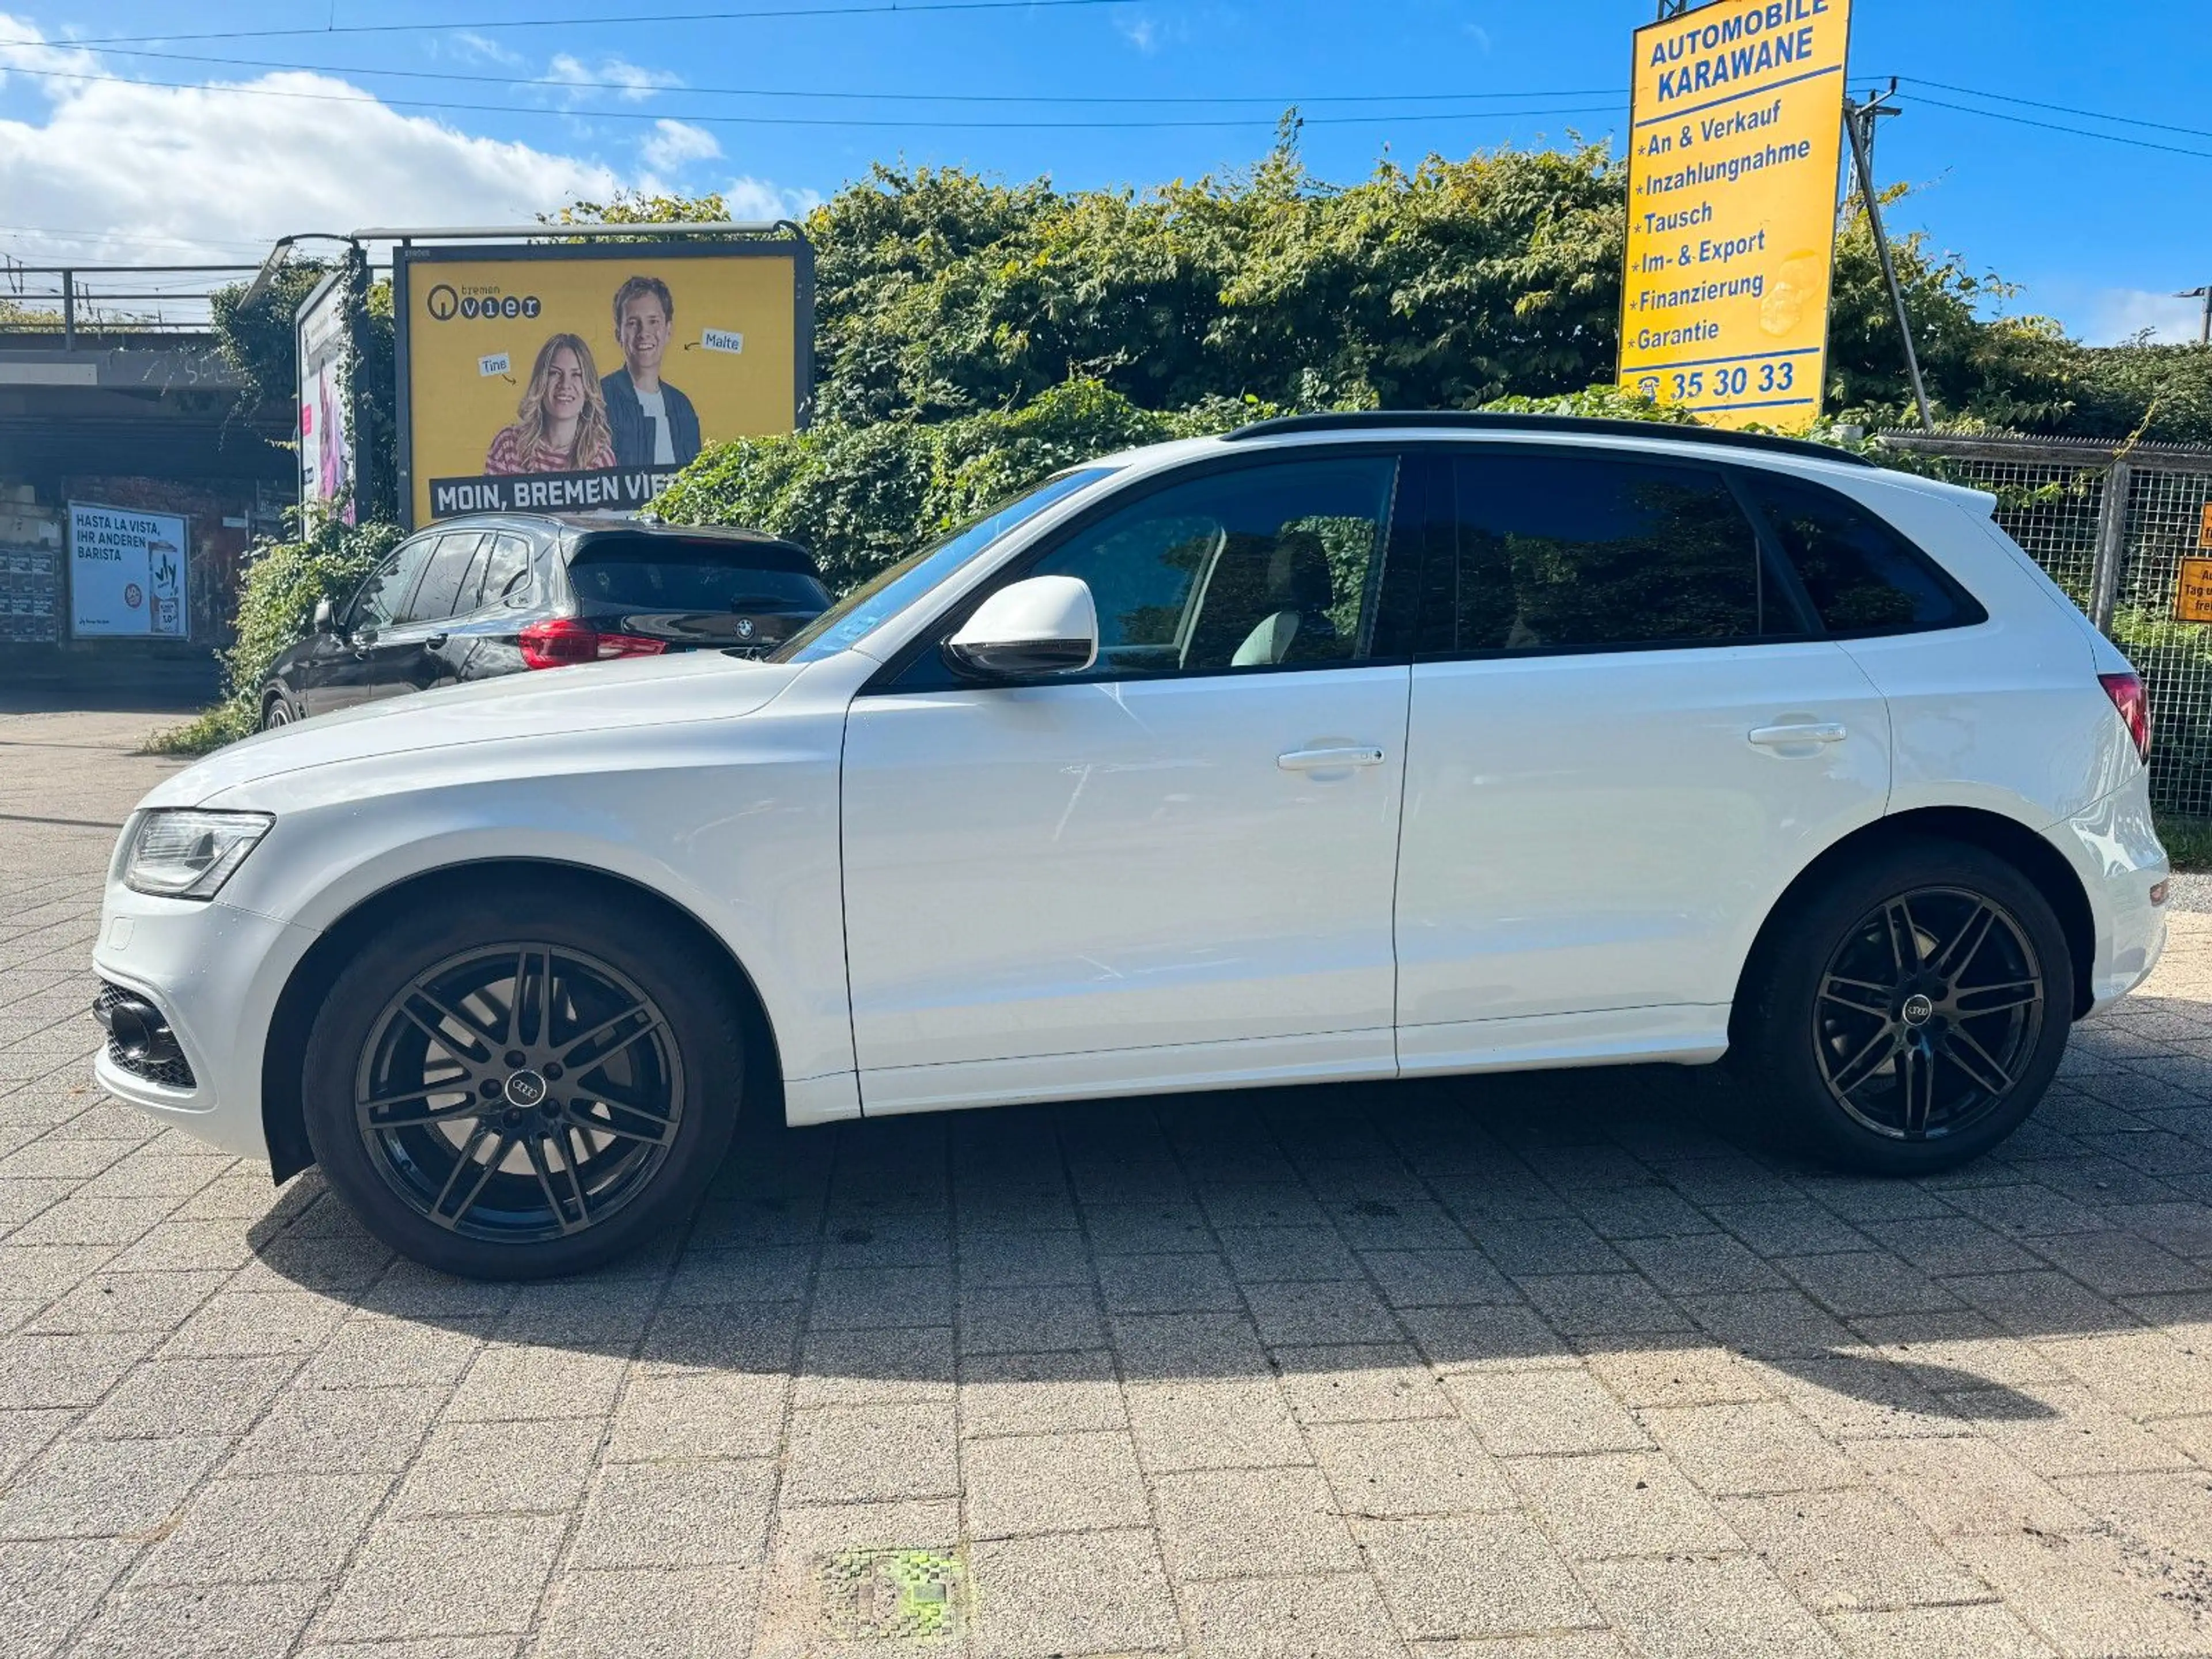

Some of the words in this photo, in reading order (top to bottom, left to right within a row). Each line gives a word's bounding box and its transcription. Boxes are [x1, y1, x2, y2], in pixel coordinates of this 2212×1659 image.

[1650, 0, 1828, 67] AUTOMOBILE
[1658, 26, 1814, 103] KARAWANE
[1648, 134, 1671, 156] An
[1679, 125, 1692, 147] &
[1701, 99, 1781, 142] Verkauf
[1646, 140, 1810, 196] Inzahlungnahme
[1644, 201, 1713, 234] Tausch
[1642, 252, 1673, 273] Im-
[1678, 245, 1691, 266] &
[1699, 229, 1765, 263] Export
[463, 298, 539, 317] vier
[1639, 274, 1764, 312] Finanzierung
[705, 333, 739, 351] Malte
[1638, 319, 1719, 350] Garantie
[483, 359, 507, 373] Tine
[1671, 372, 1703, 400] 35
[1713, 366, 1747, 396] 30
[1758, 362, 1793, 393] 33
[437, 484, 507, 512] MOIN,
[514, 475, 619, 507] BREMEN
[76, 514, 111, 529] HASTA
[115, 518, 126, 532] LA
[129, 520, 160, 536] VISTA,
[77, 531, 95, 544] IHR
[98, 533, 146, 548] ANDEREN
[77, 546, 122, 561] BARISTA
[2186, 585, 2203, 597] Tag
